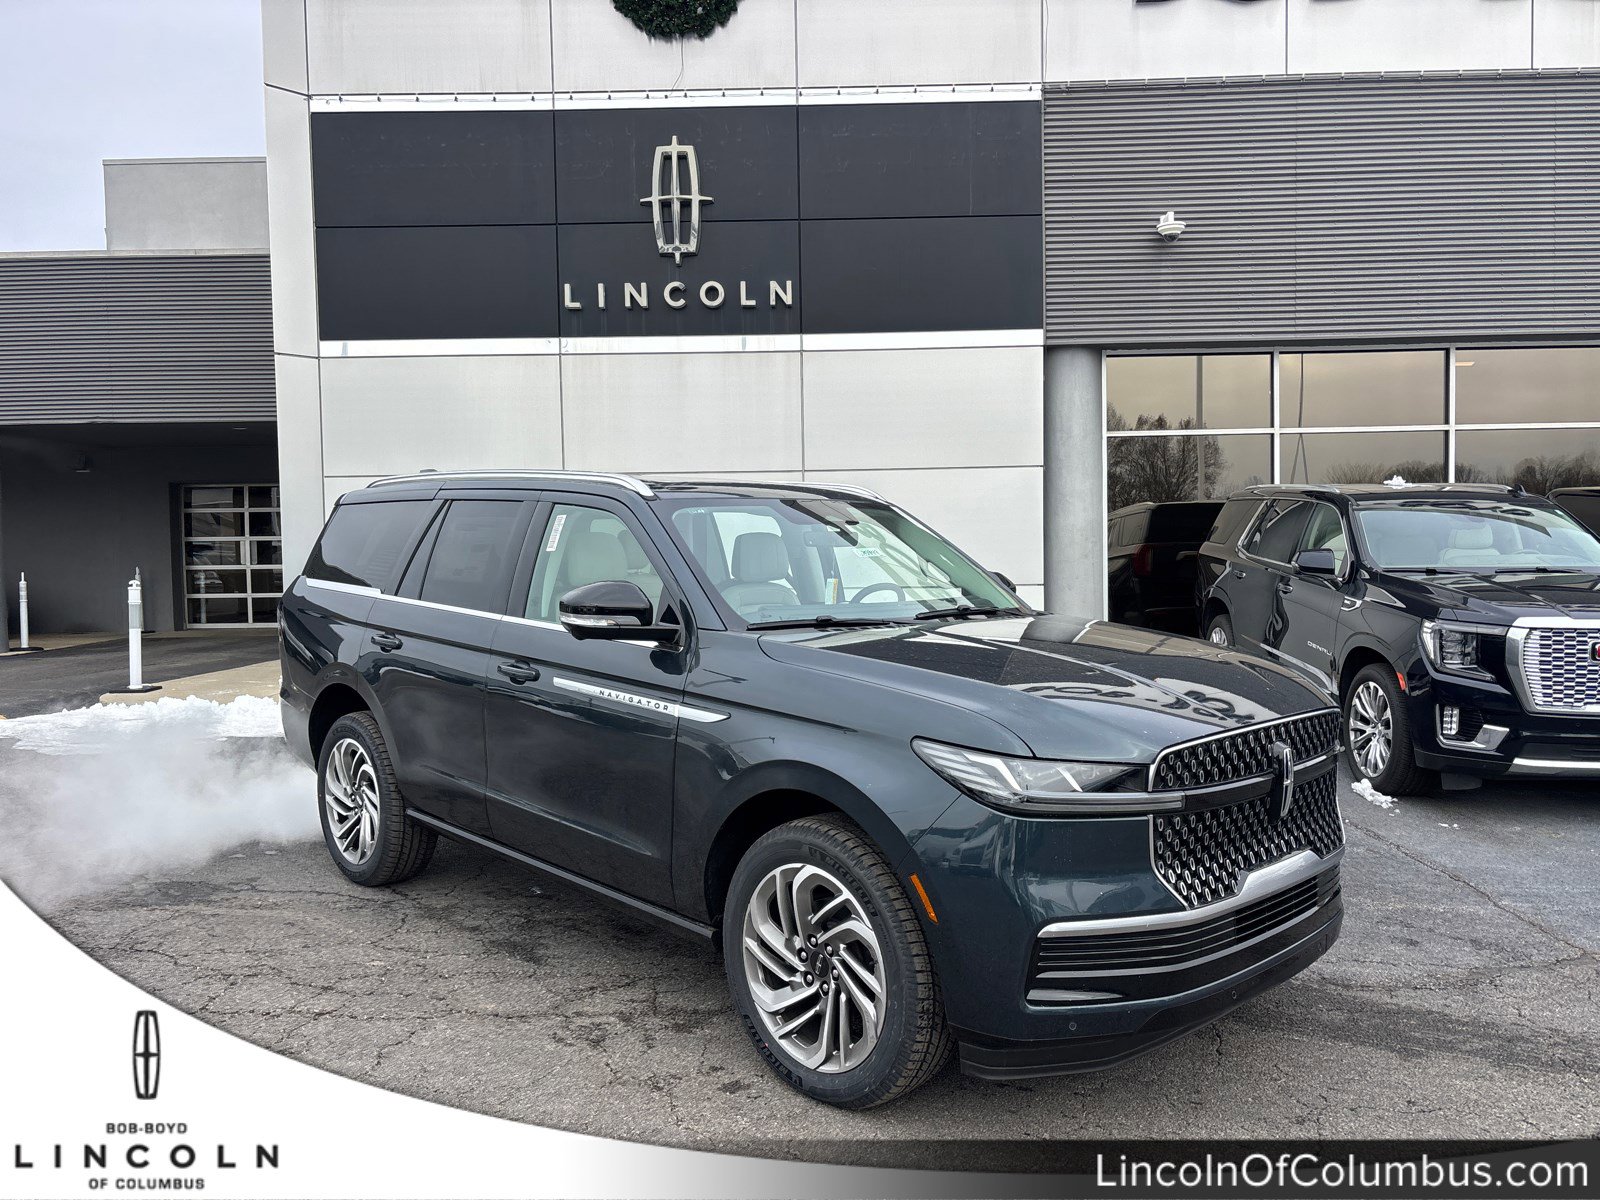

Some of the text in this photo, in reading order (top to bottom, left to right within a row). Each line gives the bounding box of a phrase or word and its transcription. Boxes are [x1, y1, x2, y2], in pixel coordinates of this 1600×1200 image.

[564, 279, 793, 309] LINCOLN
[1307, 640, 1333, 656] DENALI
[599, 689, 670, 712] NAVIGATOR
